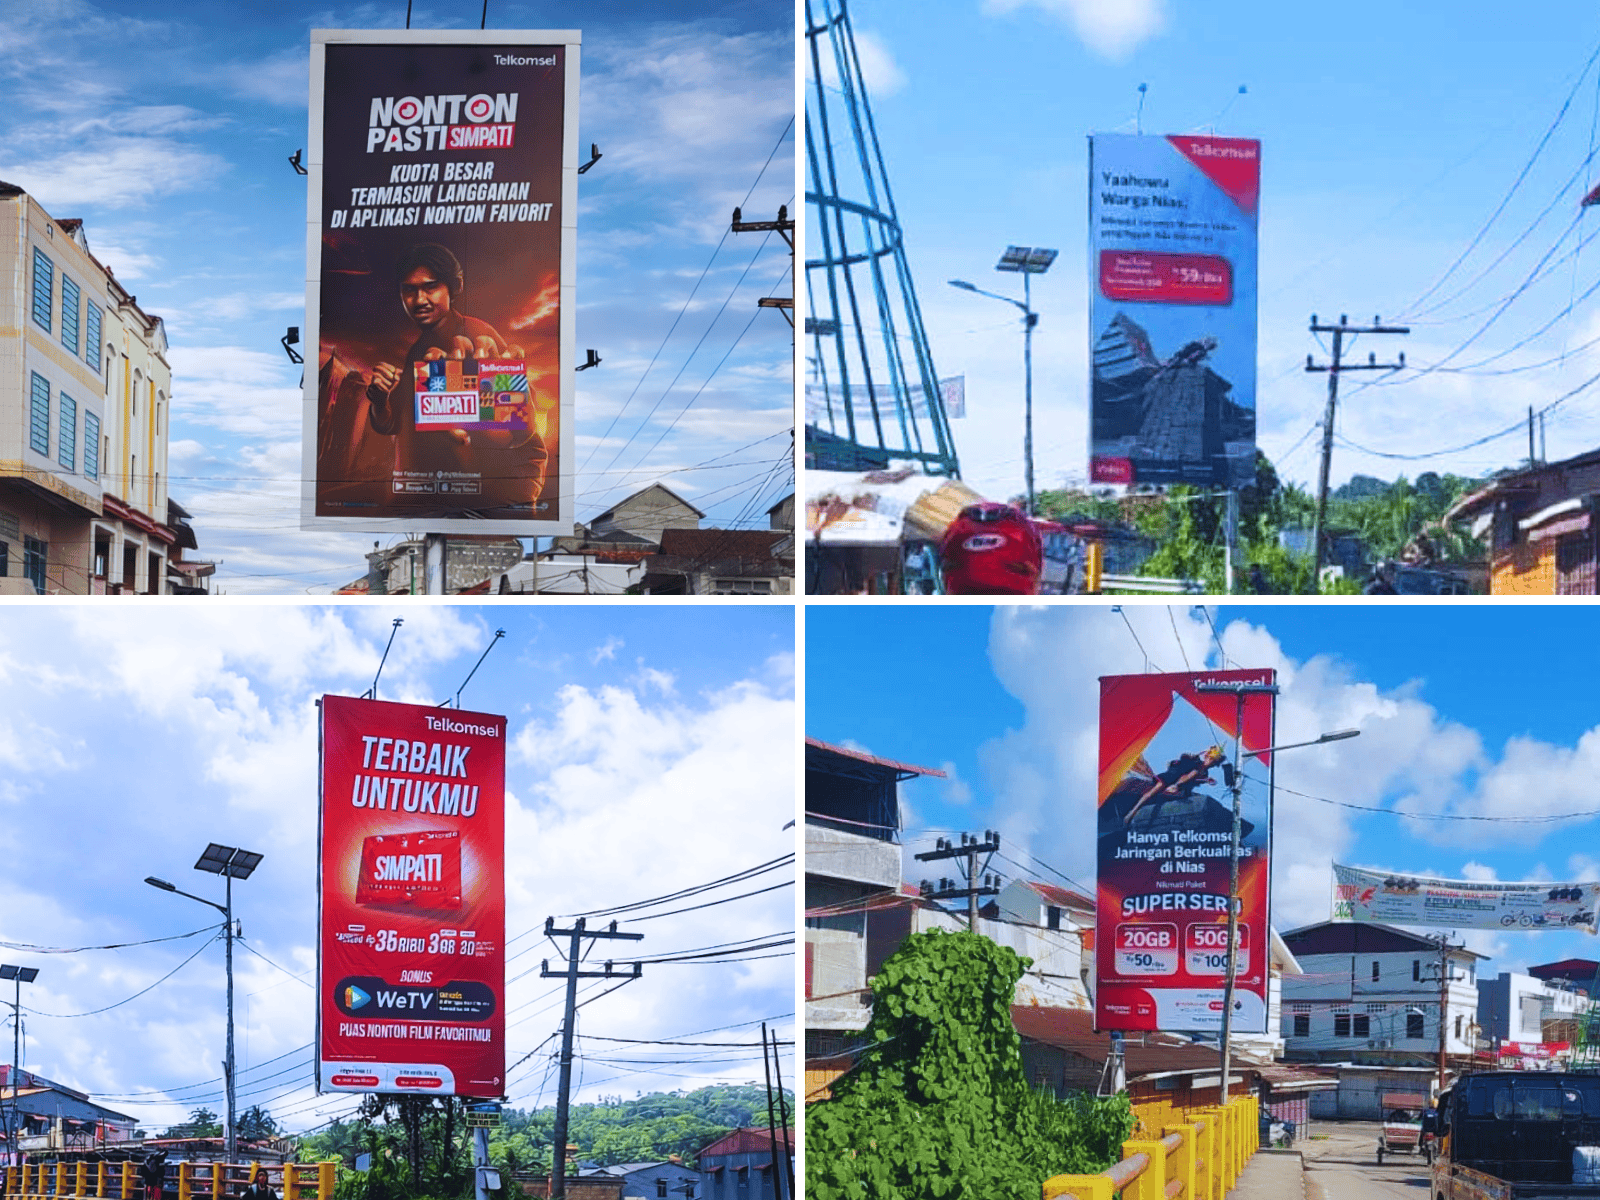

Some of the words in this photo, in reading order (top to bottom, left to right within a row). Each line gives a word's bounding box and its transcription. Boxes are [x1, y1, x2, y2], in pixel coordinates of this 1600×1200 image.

[494, 54, 557, 66] Telkomsel
[369, 93, 519, 127] NONTON
[366, 125, 448, 153] PASTI
[449, 125, 514, 148] SIMPATI
[390, 163, 439, 183] KUOTA
[443, 161, 494, 181] BESAR
[350, 186, 434, 206] TERMASUK
[436, 182, 530, 202] LANGGANAN
[330, 210, 348, 228] DI
[350, 206, 420, 228] APLIKASI
[423, 204, 487, 225] NONTON
[489, 203, 553, 223] FAVORIT
[422, 395, 476, 414] SIMPATI
[425, 715, 499, 737] Telkomsel
[362, 735, 471, 778] TERBAIK
[351, 774, 479, 818] UNTUKMU
[1126, 831, 1169, 845] Hanya
[1114, 846, 1172, 861] Jaringan
[374, 853, 443, 882] SIMPATI
[1160, 861, 1173, 874] di
[1175, 861, 1206, 874] Nias
[1122, 893, 1187, 917] SUPER
[1124, 931, 1171, 947] 20GB
[400, 970, 433, 983] BONUS
[377, 990, 434, 1010] WeTV
[339, 1022, 366, 1037] PUAS
[367, 1024, 408, 1039] NONTON
[409, 1025, 433, 1040] FILM
